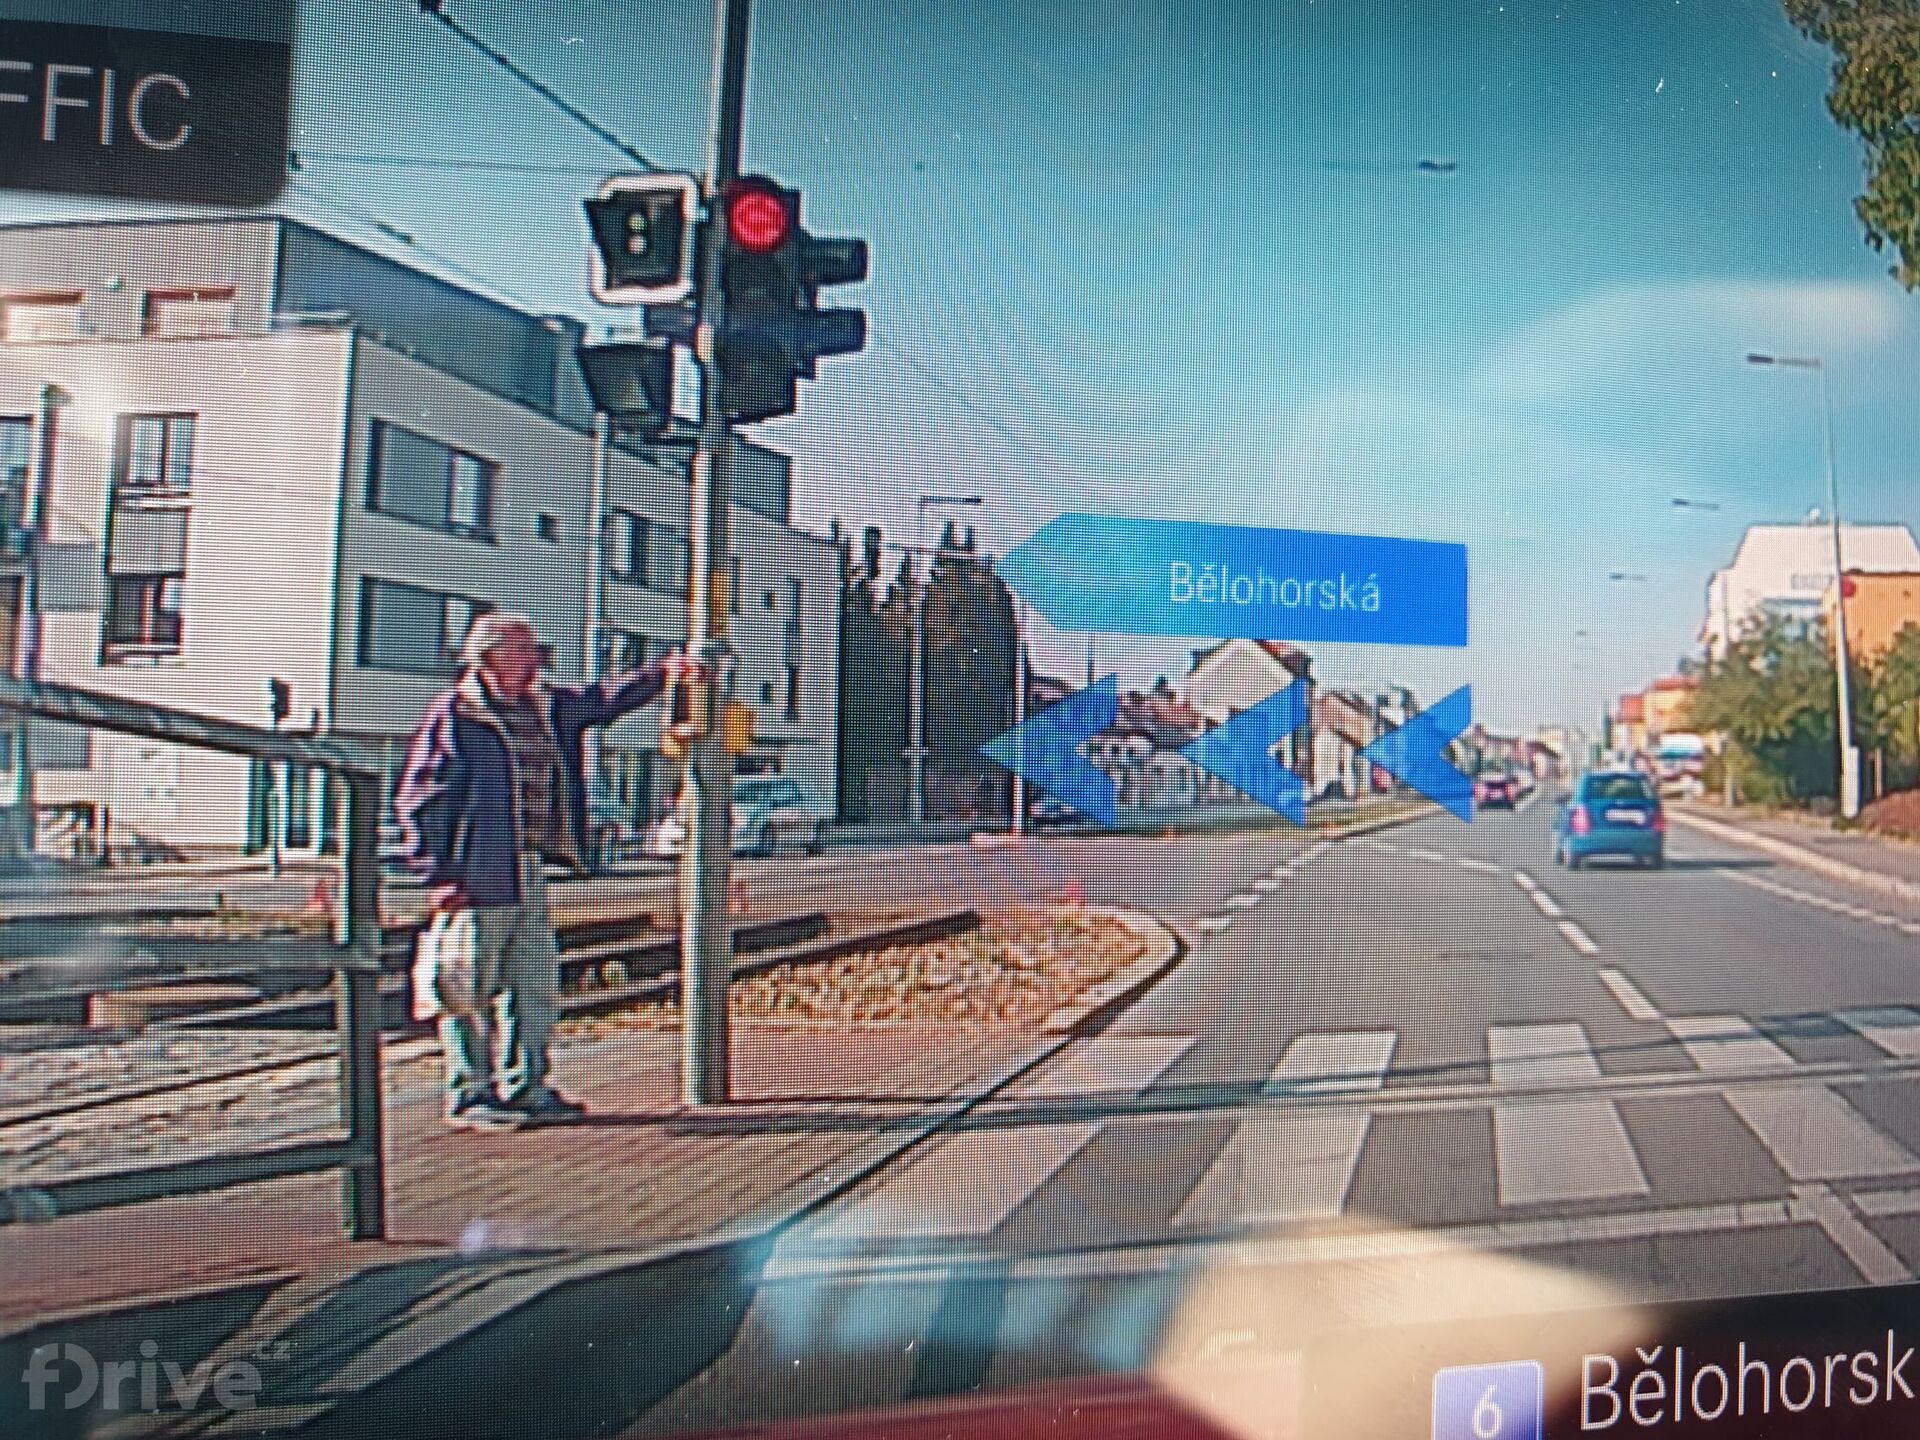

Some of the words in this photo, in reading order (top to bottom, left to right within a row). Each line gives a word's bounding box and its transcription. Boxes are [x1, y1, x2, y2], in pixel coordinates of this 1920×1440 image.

[1170, 561, 1382, 613] Bělohorská
[1472, 1384, 1502, 1439] 6
[1580, 1328, 1916, 1431] Bělohorsk
